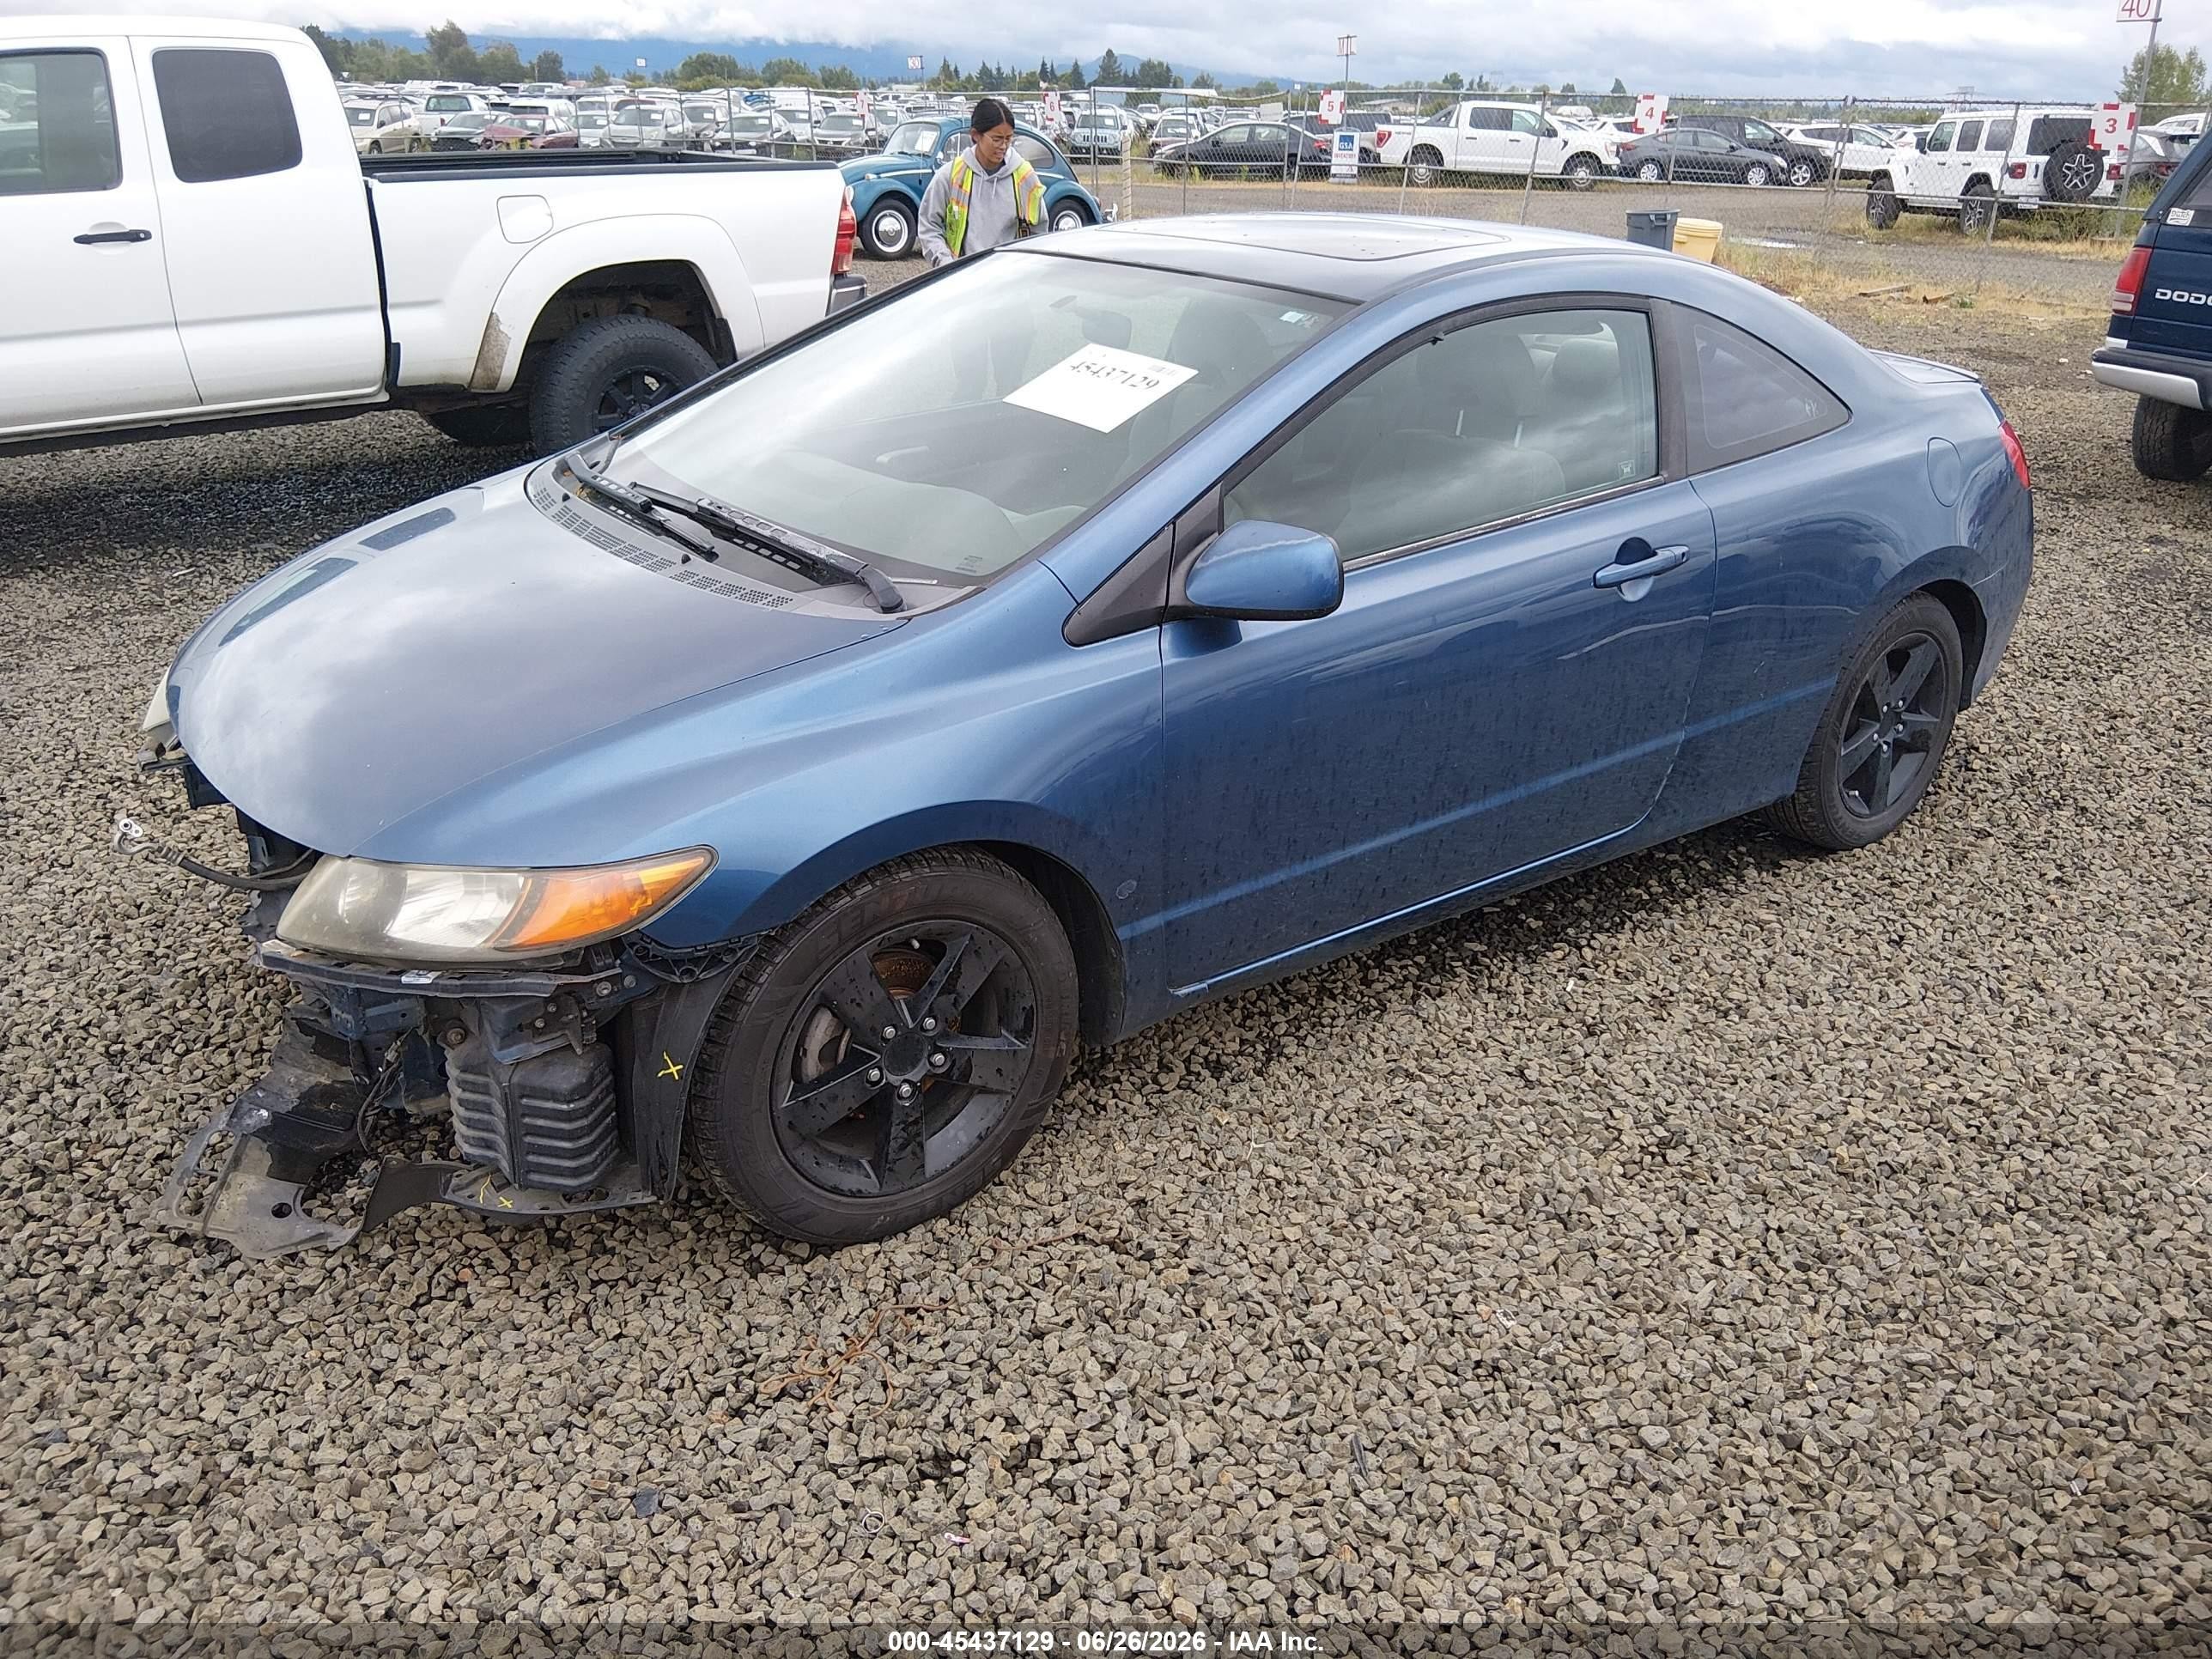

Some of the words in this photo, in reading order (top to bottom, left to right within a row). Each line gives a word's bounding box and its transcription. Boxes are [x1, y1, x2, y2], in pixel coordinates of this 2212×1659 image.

[2121, 0, 2150, 18] 40
[1049, 101, 1055, 111] 6
[1328, 101, 1334, 112] 5
[1645, 106, 1655, 119] 4
[2105, 118, 2118, 133] 3
[1070, 362, 1160, 389] 45437129
